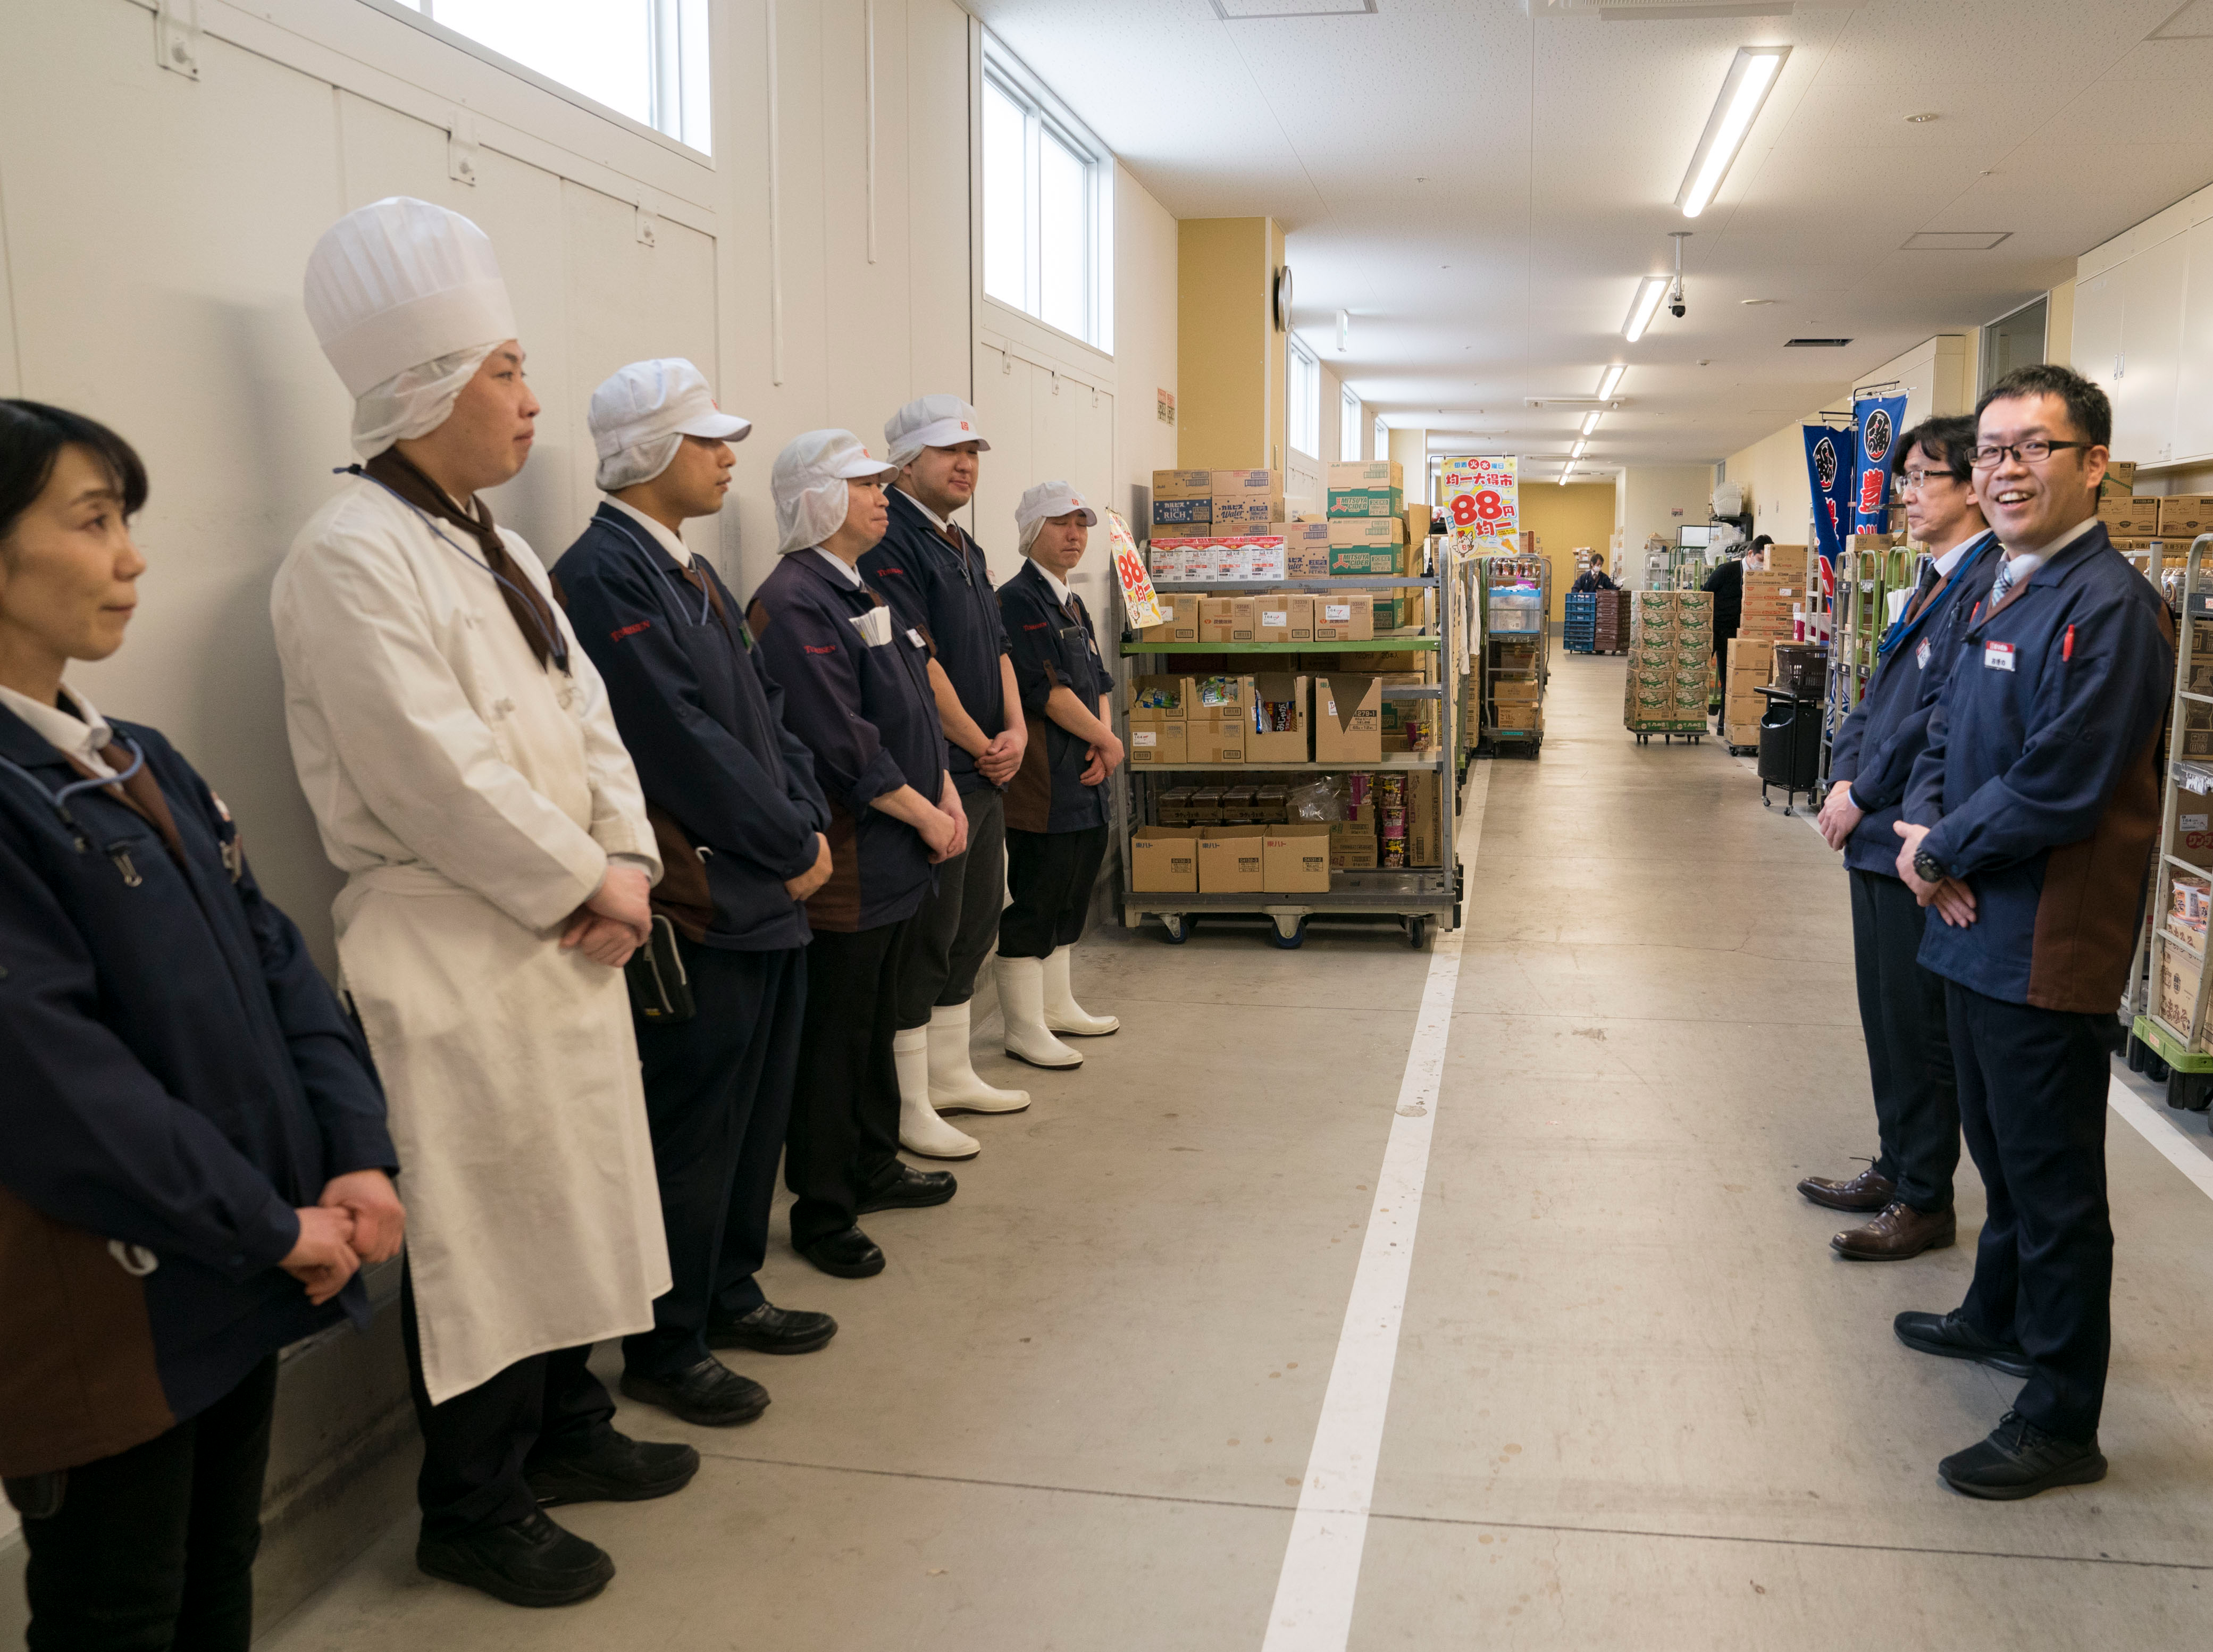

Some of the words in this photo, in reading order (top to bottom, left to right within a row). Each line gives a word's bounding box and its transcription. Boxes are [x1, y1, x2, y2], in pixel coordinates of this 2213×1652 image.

[1446, 473, 1513, 486] 均一大得市
[1476, 520, 1512, 536] 均一
